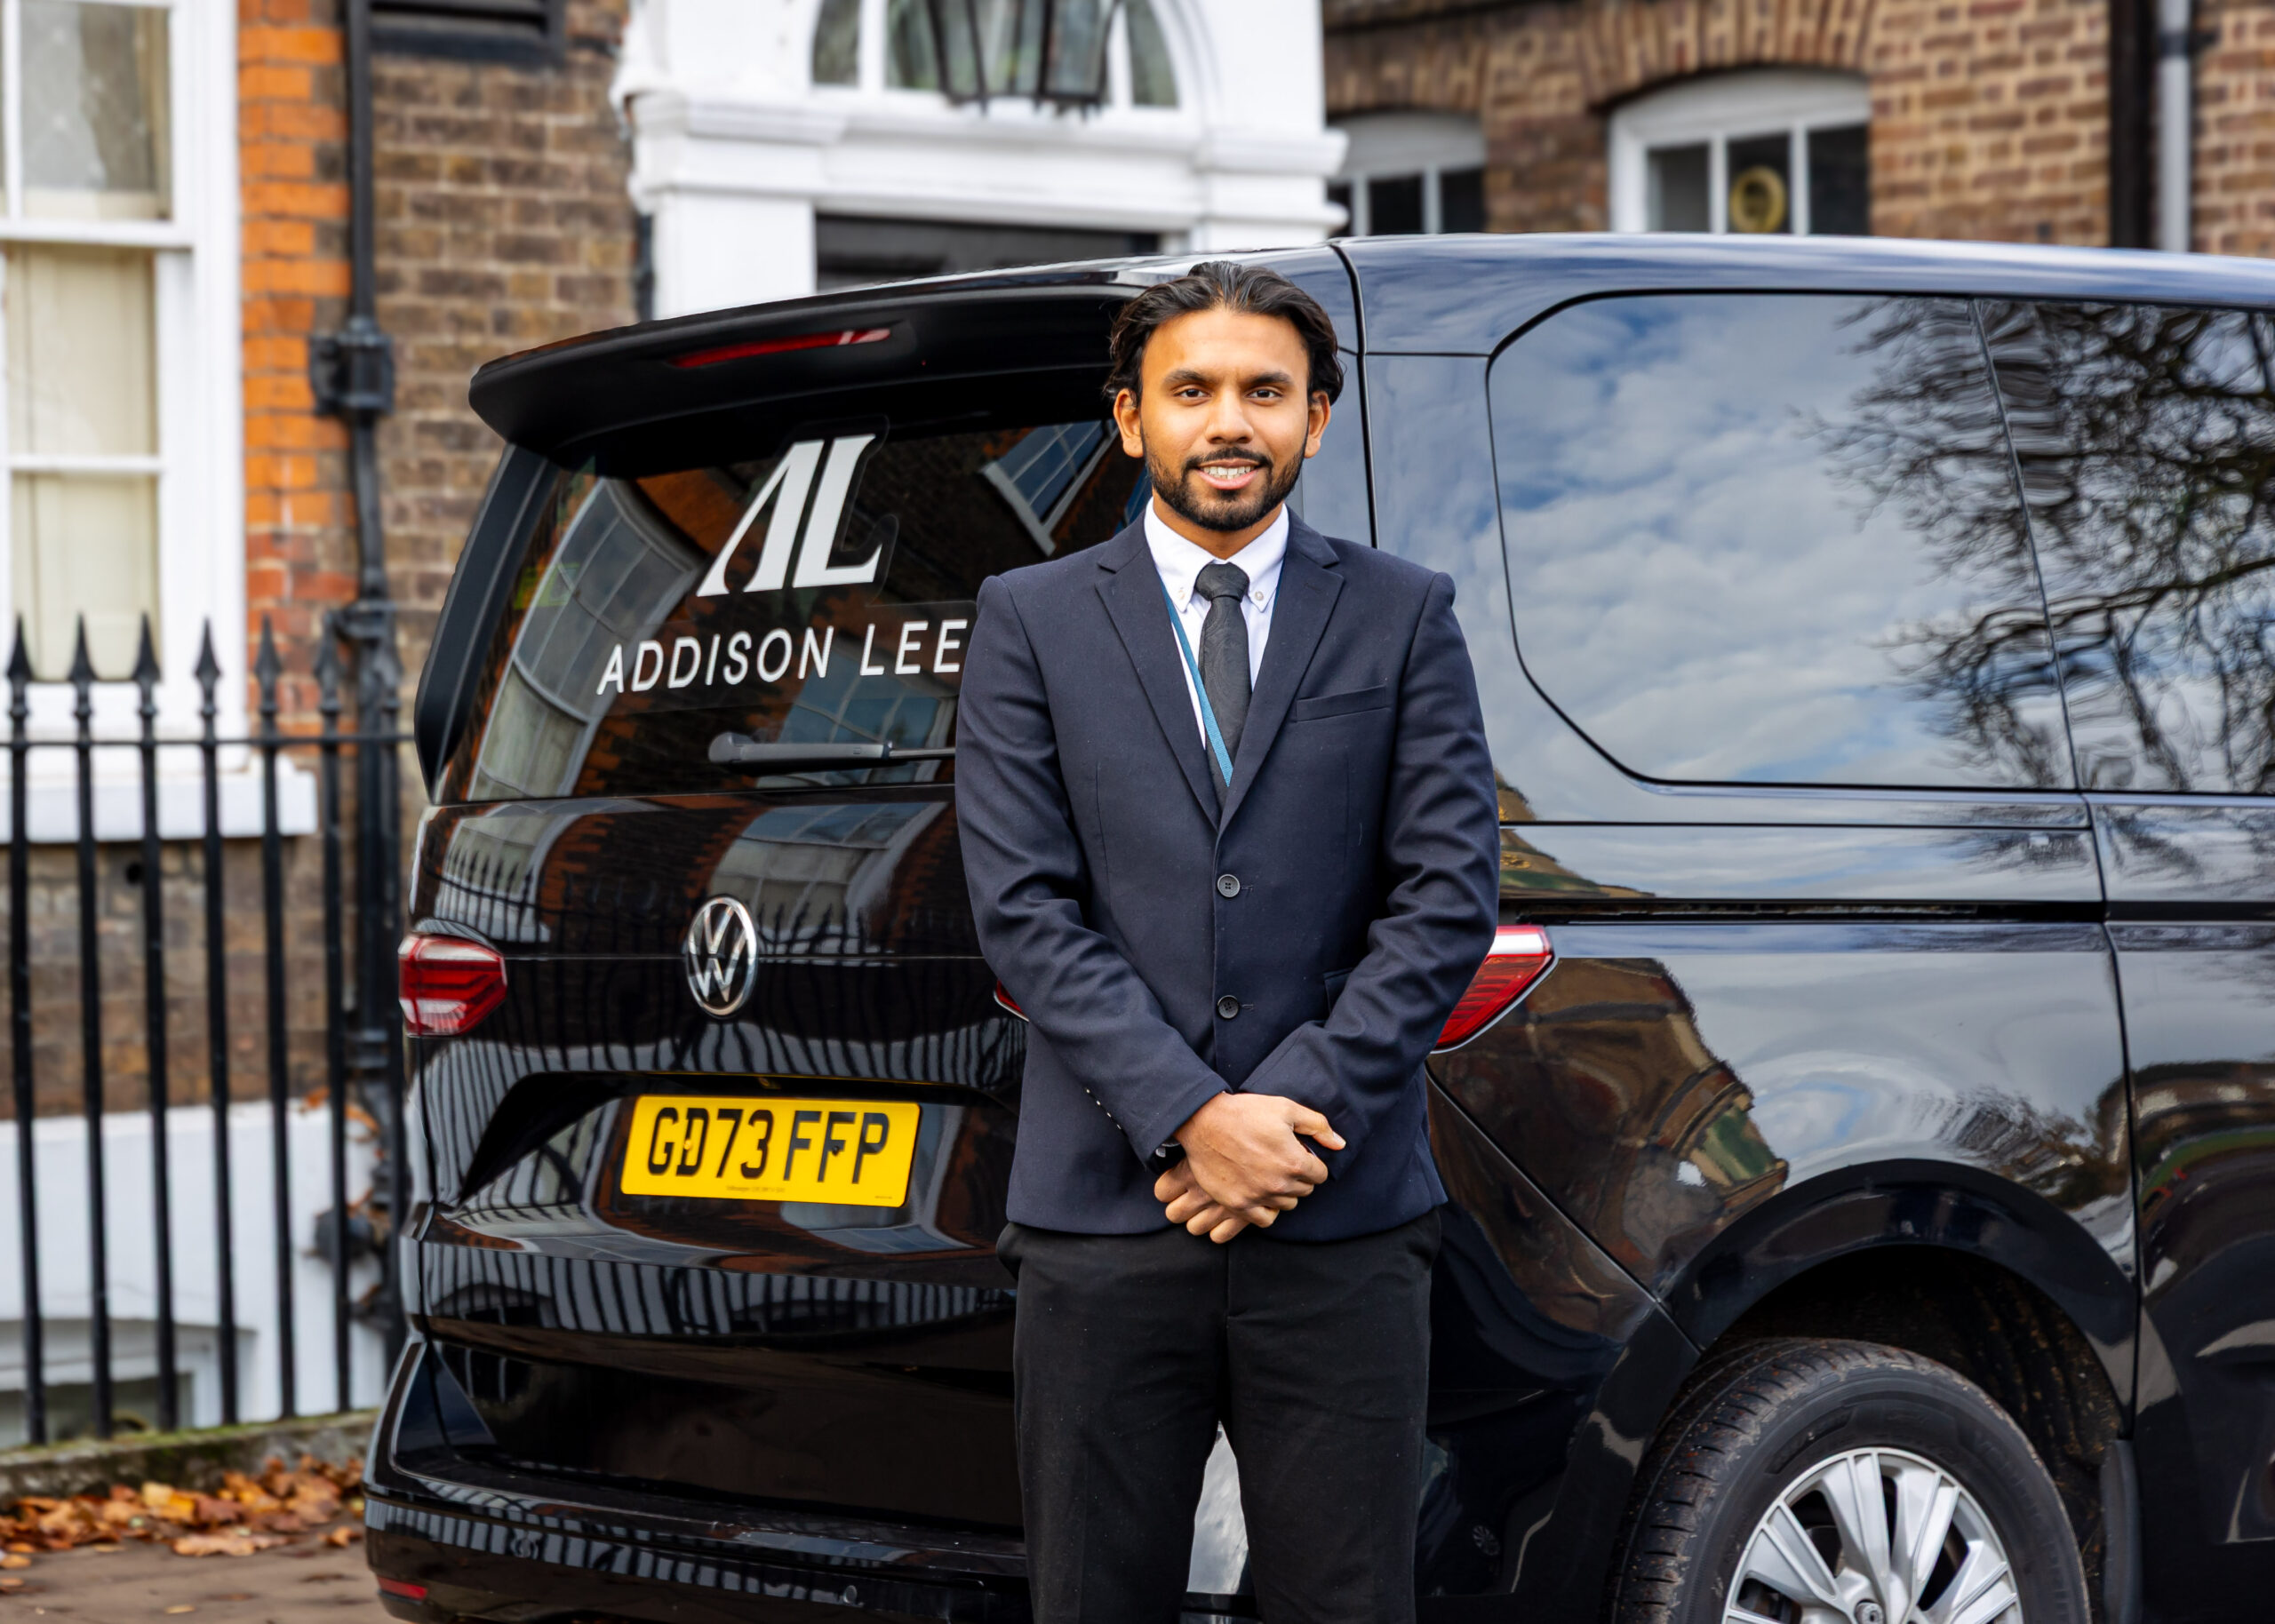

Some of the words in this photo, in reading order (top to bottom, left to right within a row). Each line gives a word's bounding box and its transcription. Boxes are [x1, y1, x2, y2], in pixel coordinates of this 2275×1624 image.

[696, 433, 882, 597] AL
[596, 625, 834, 696] ADDISON
[858, 618, 969, 677] LEE
[688, 901, 751, 1005] VW
[647, 1107, 775, 1180] GD73
[783, 1110, 890, 1185] FFP
